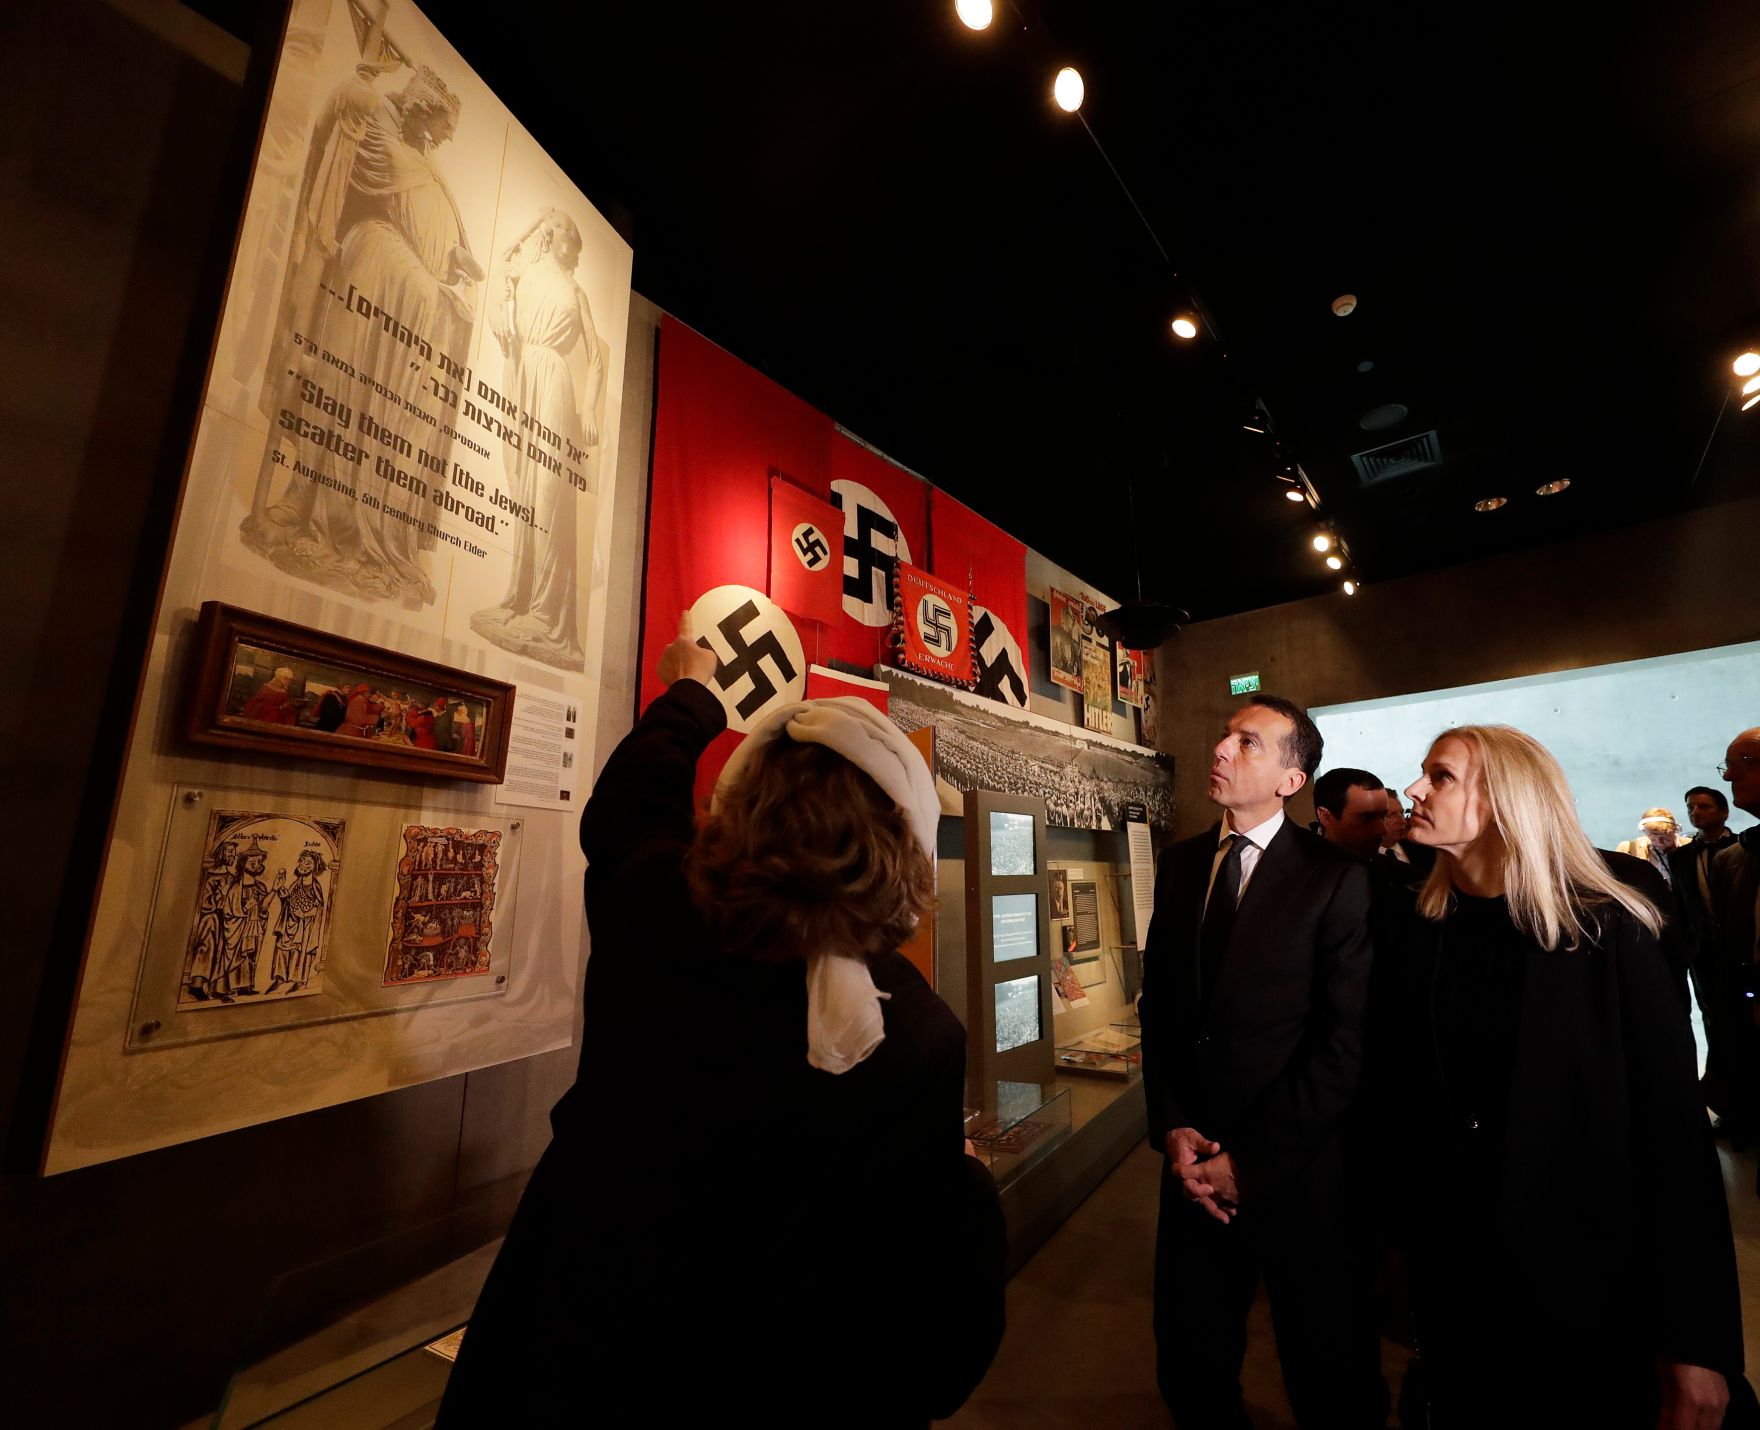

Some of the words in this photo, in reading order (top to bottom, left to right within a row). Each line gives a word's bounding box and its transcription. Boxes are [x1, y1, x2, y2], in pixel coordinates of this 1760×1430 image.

[321, 350, 356, 379] במאה
[359, 372, 402, 406] הכנסייה
[477, 379, 518, 421] אותם
[403, 400, 437, 427] מאבות
[462, 399, 522, 451] בארצות
[521, 411, 562, 451] תהרוג
[278, 408, 370, 467] scatter
[375, 455, 428, 499] them
[358, 411, 413, 459] them
[417, 448, 449, 478] not
[452, 463, 485, 498] [the
[527, 441, 562, 477] אותם
[566, 467, 587, 493] פזר
[271, 449, 290, 469] St.
[361, 492, 380, 511] 5th
[382, 503, 426, 533] century
[427, 523, 462, 549] Church
[463, 540, 488, 560] Elder
[907, 573, 962, 604] DEUTSCHLAND
